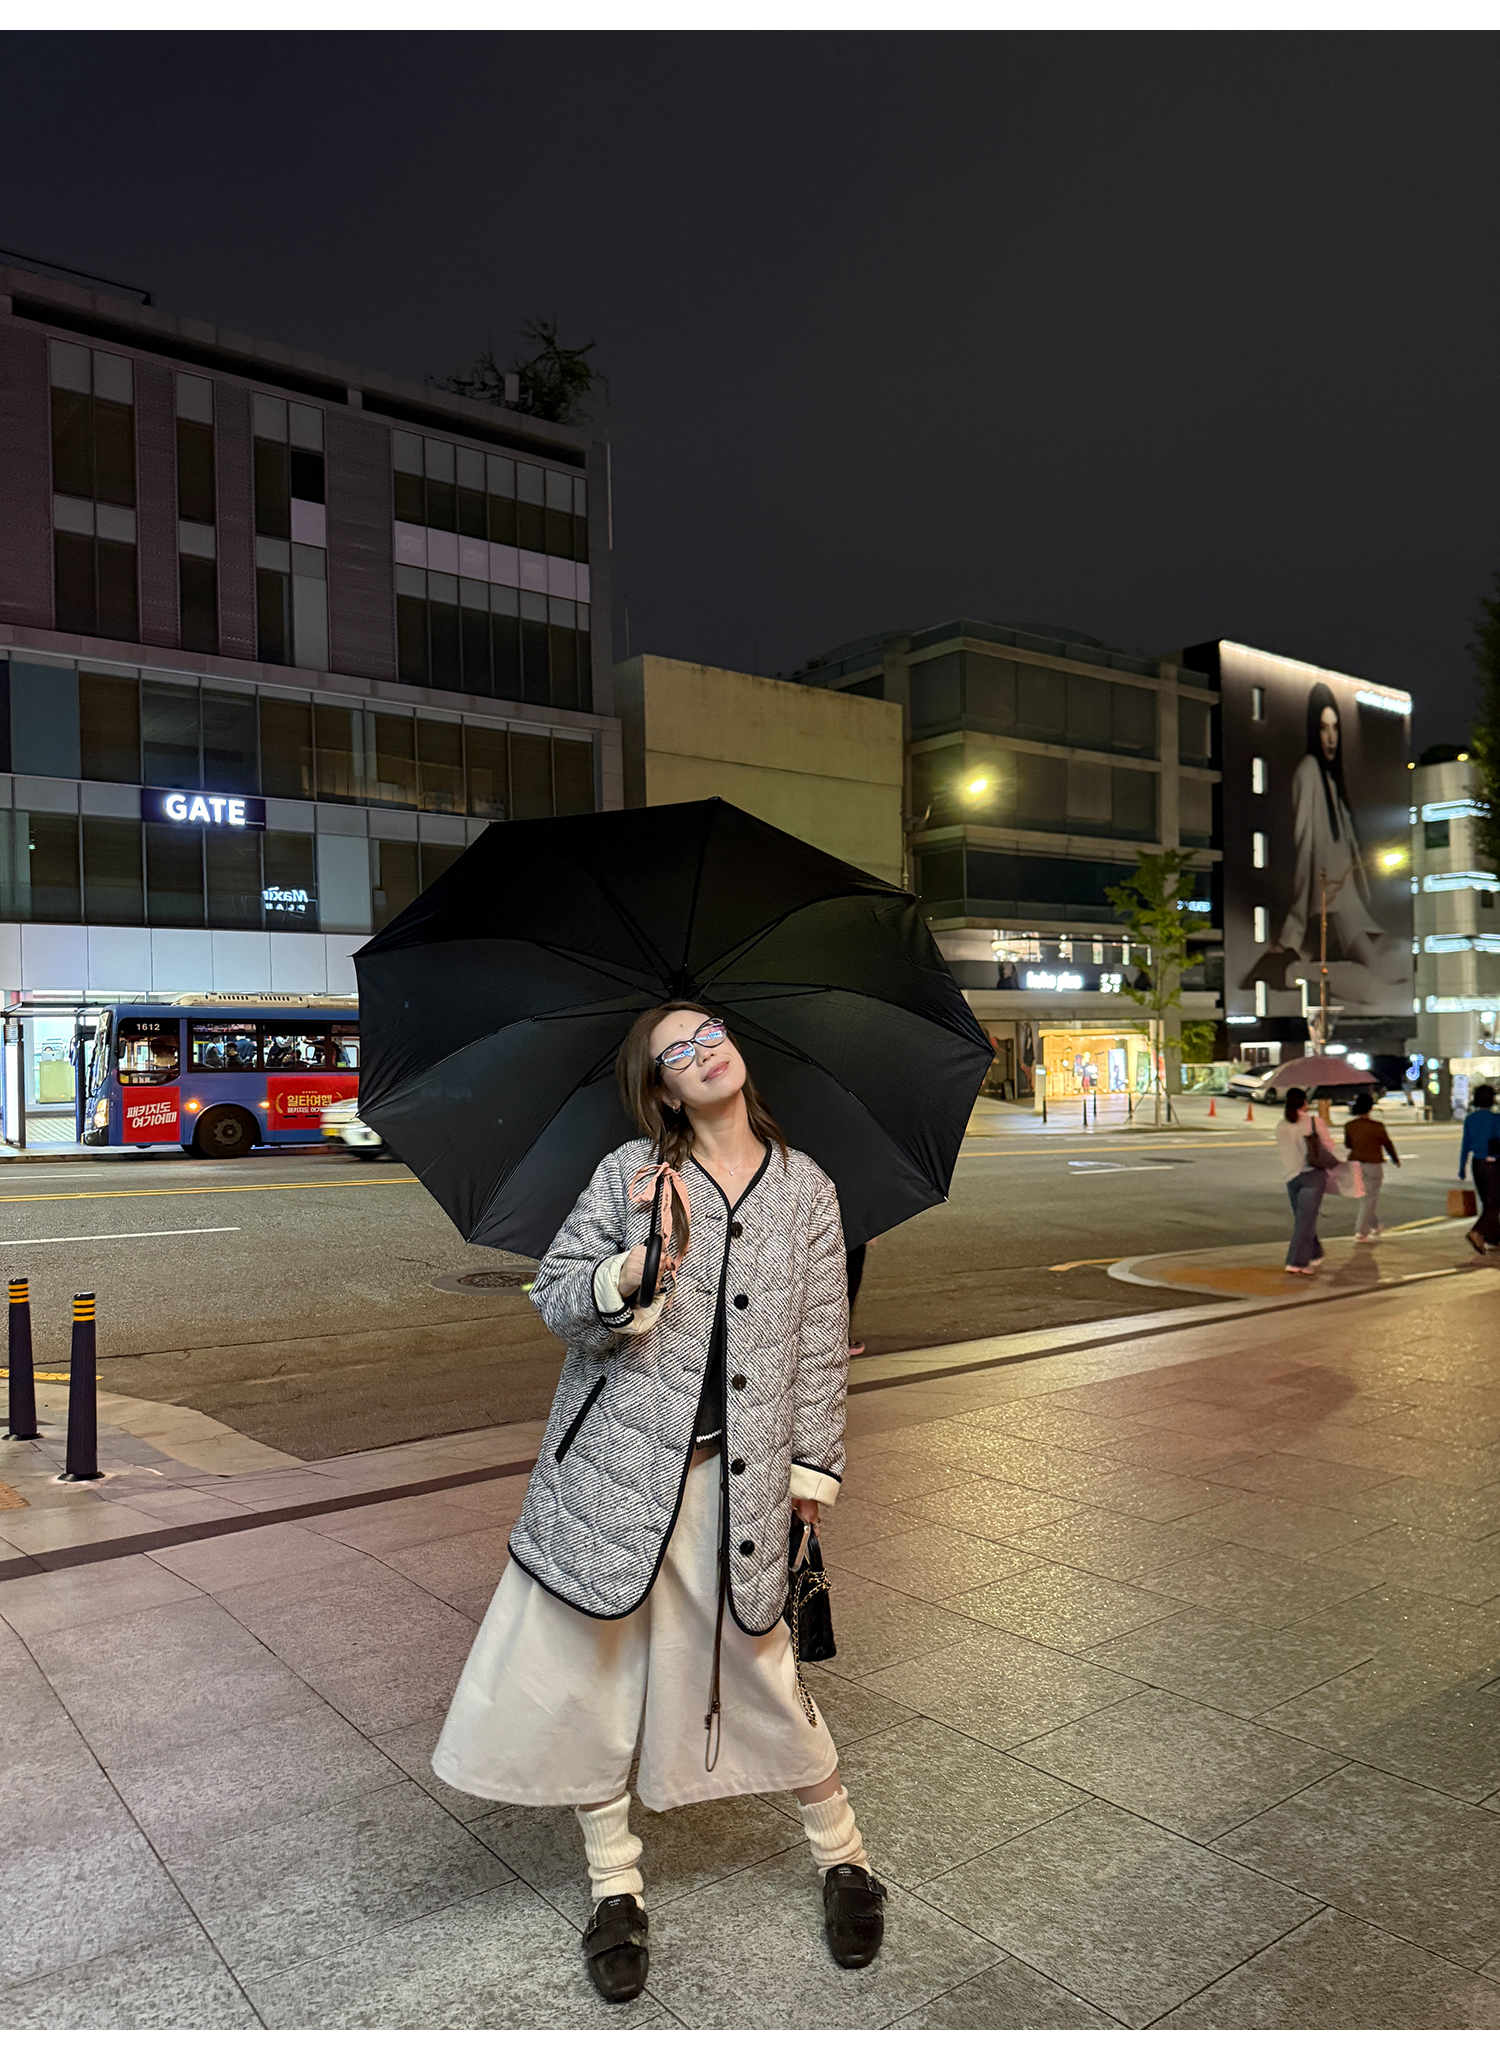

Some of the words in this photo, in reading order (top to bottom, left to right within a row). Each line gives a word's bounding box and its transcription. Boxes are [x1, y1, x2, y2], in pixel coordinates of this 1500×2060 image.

[136, 1023, 161, 1031] 1612
[126, 1101, 171, 1118] 패키지도
[132, 1111, 178, 1128] 여기어때
